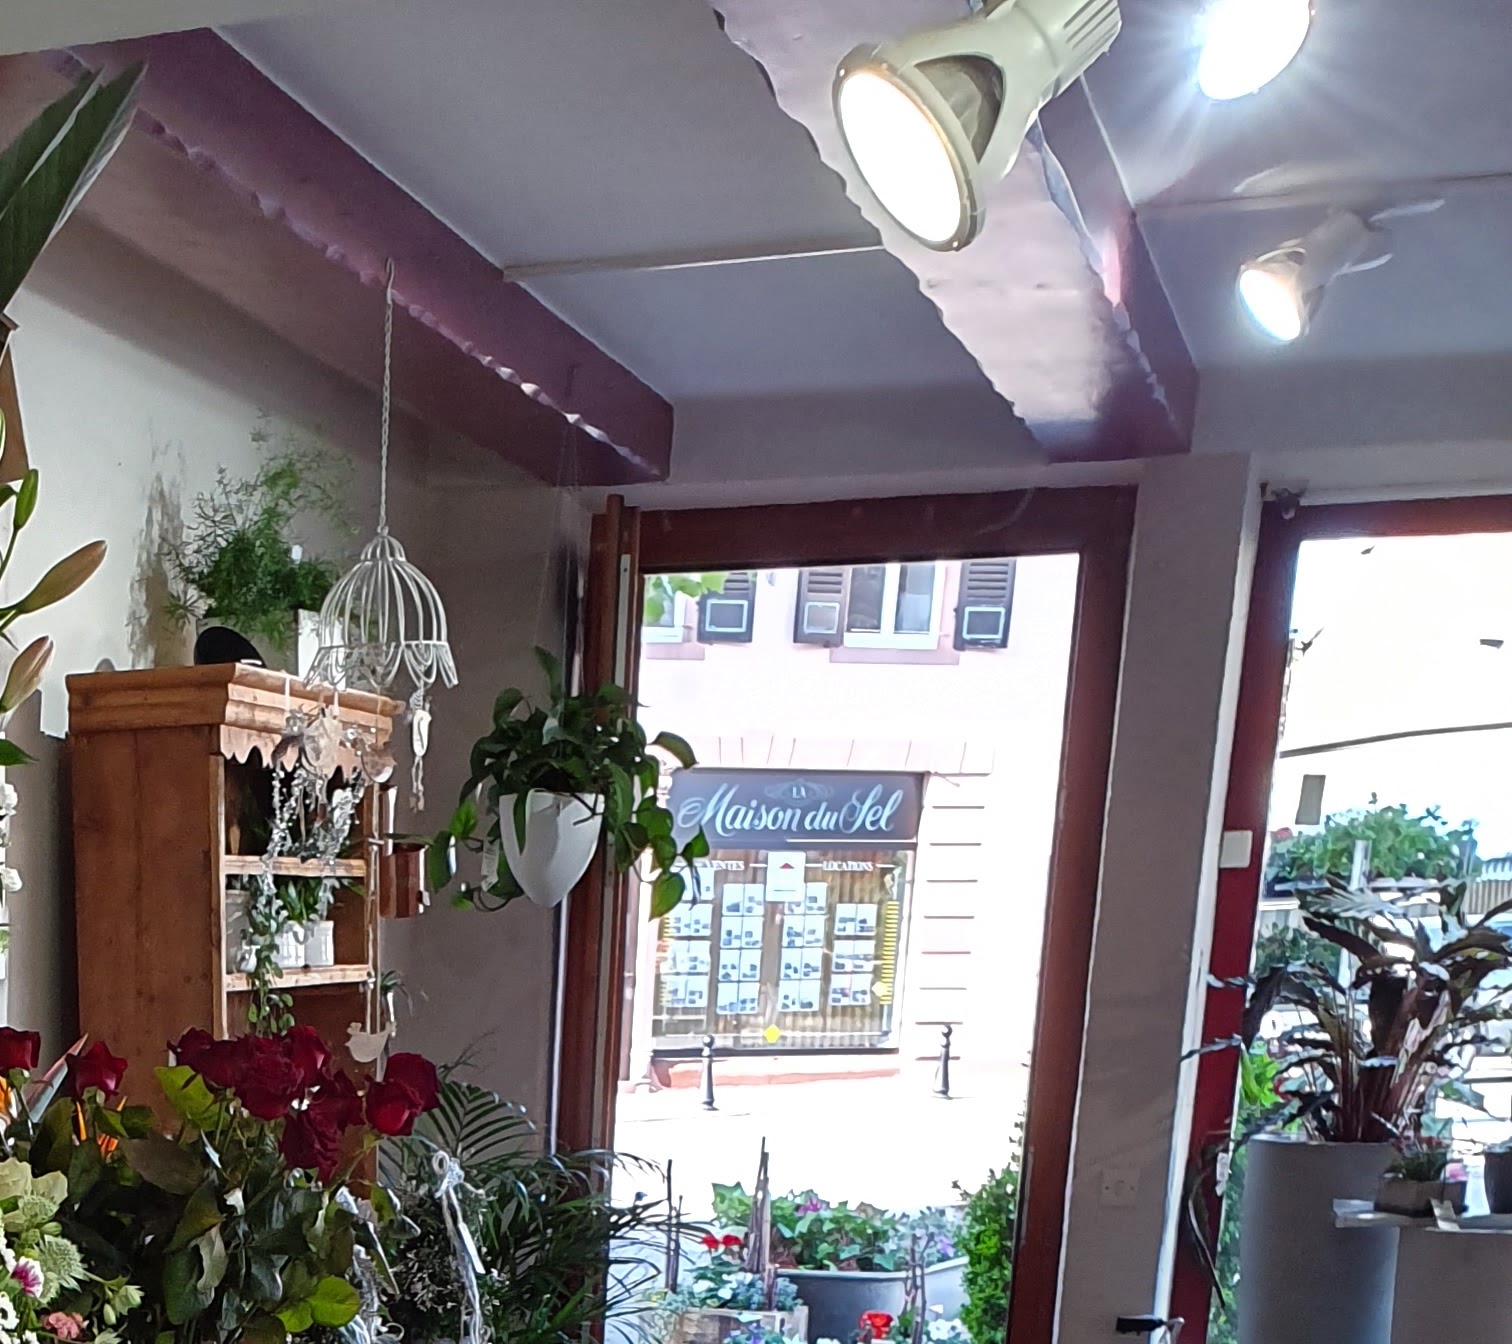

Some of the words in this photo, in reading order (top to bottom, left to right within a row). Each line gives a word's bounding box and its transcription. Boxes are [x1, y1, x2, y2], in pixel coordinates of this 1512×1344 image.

[677, 782, 801, 837] Maison
[804, 801, 838, 832] du
[838, 783, 904, 835] Sel
